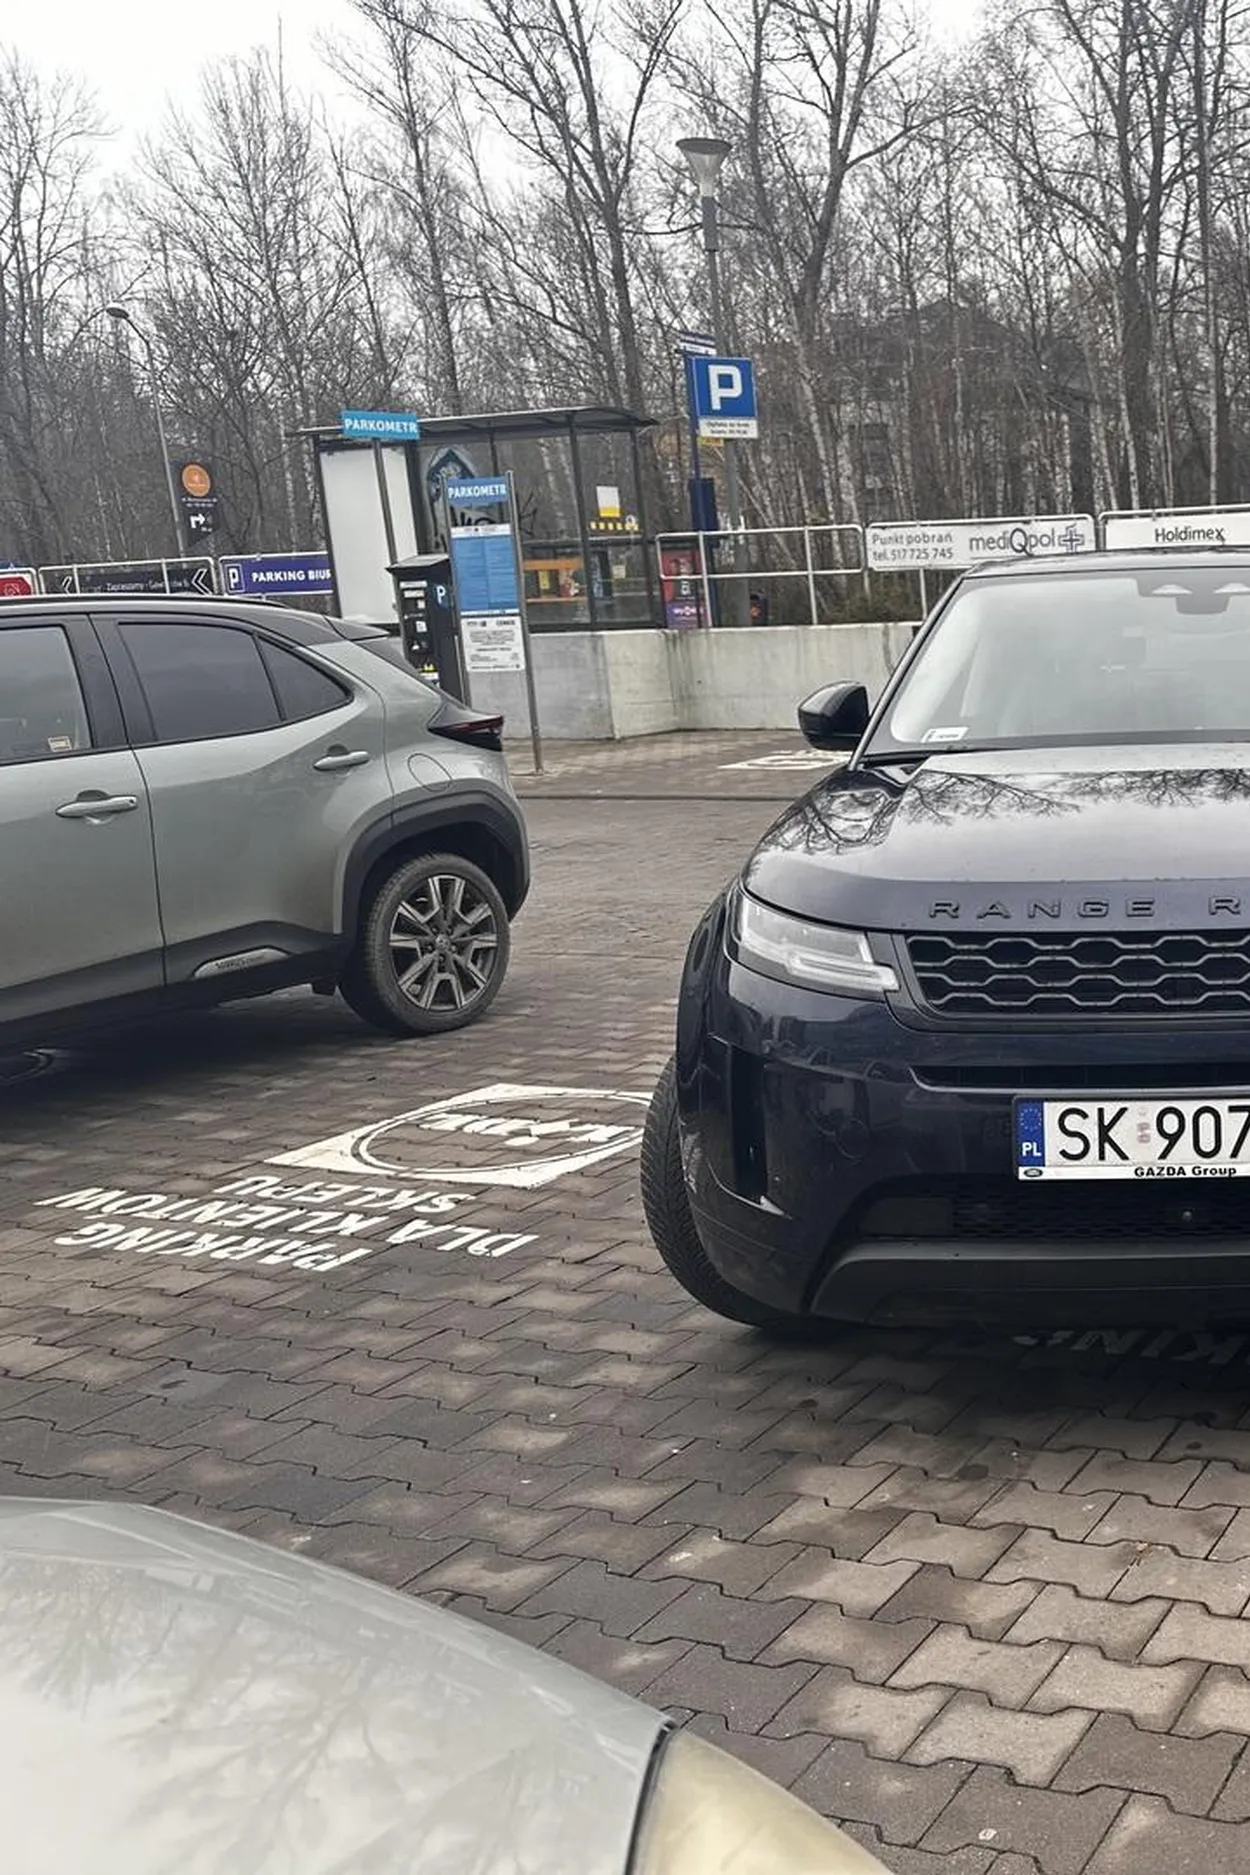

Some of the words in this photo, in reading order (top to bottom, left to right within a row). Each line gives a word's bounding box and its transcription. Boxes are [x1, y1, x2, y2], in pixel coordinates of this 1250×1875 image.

[708, 364, 743, 410] P
[344, 418, 418, 433] PARKOMETR
[448, 484, 507, 499] PARKOMETR
[872, 532, 904, 545] Punkt
[969, 527, 1056, 557] mediQpol
[1154, 525, 1225, 543] Holdimex
[932, 546, 953, 560] 745
[228, 567, 239, 589] P
[252, 570, 306, 582] PARKING
[928, 898, 1156, 920] RANGE
[1057, 1106, 1130, 1161] SK
[1022, 1143, 1042, 1157] PL
[1134, 1165, 1187, 1178] GAZDA
[1191, 1165, 1237, 1178] Group
[214, 1176, 476, 1213] SKLEPU
[36, 1187, 391, 1237] KLIENTÓW
[54, 1222, 373, 1271] PARKING
[386, 1219, 539, 1257] DLA
